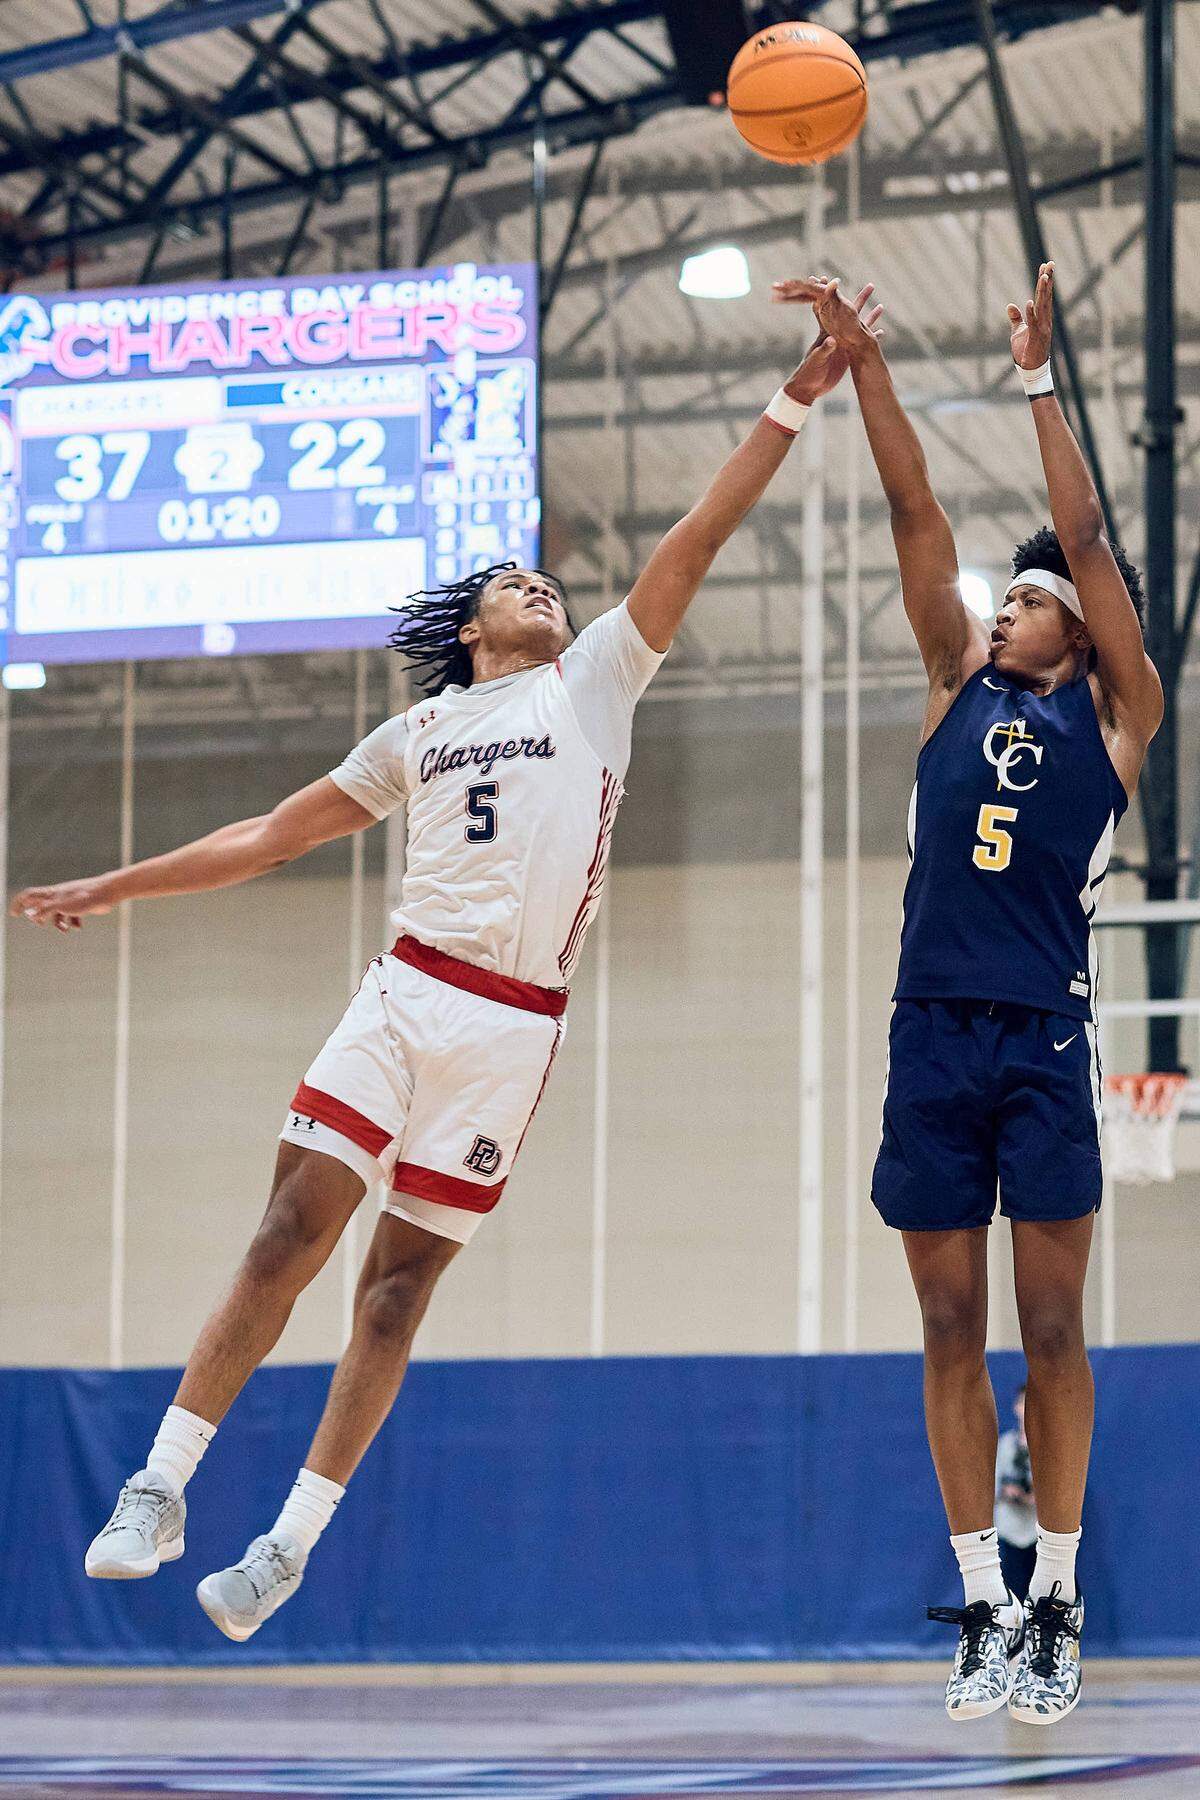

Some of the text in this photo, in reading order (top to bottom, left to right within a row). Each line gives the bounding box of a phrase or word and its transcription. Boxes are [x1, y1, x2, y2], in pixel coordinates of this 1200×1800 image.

[51, 275, 524, 327] PROVIDENCE DAY SCHOOL
[52, 303, 527, 379] CHARGERS
[55, 430, 151, 503] 37
[287, 418, 387, 491] 22
[41, 522, 66, 553] 4
[157, 495, 281, 543] 01:20
[374, 504, 399, 535] 4
[420, 733, 556, 784] Chargers
[464, 781, 499, 844] 5
[972, 803, 1019, 872] 5
